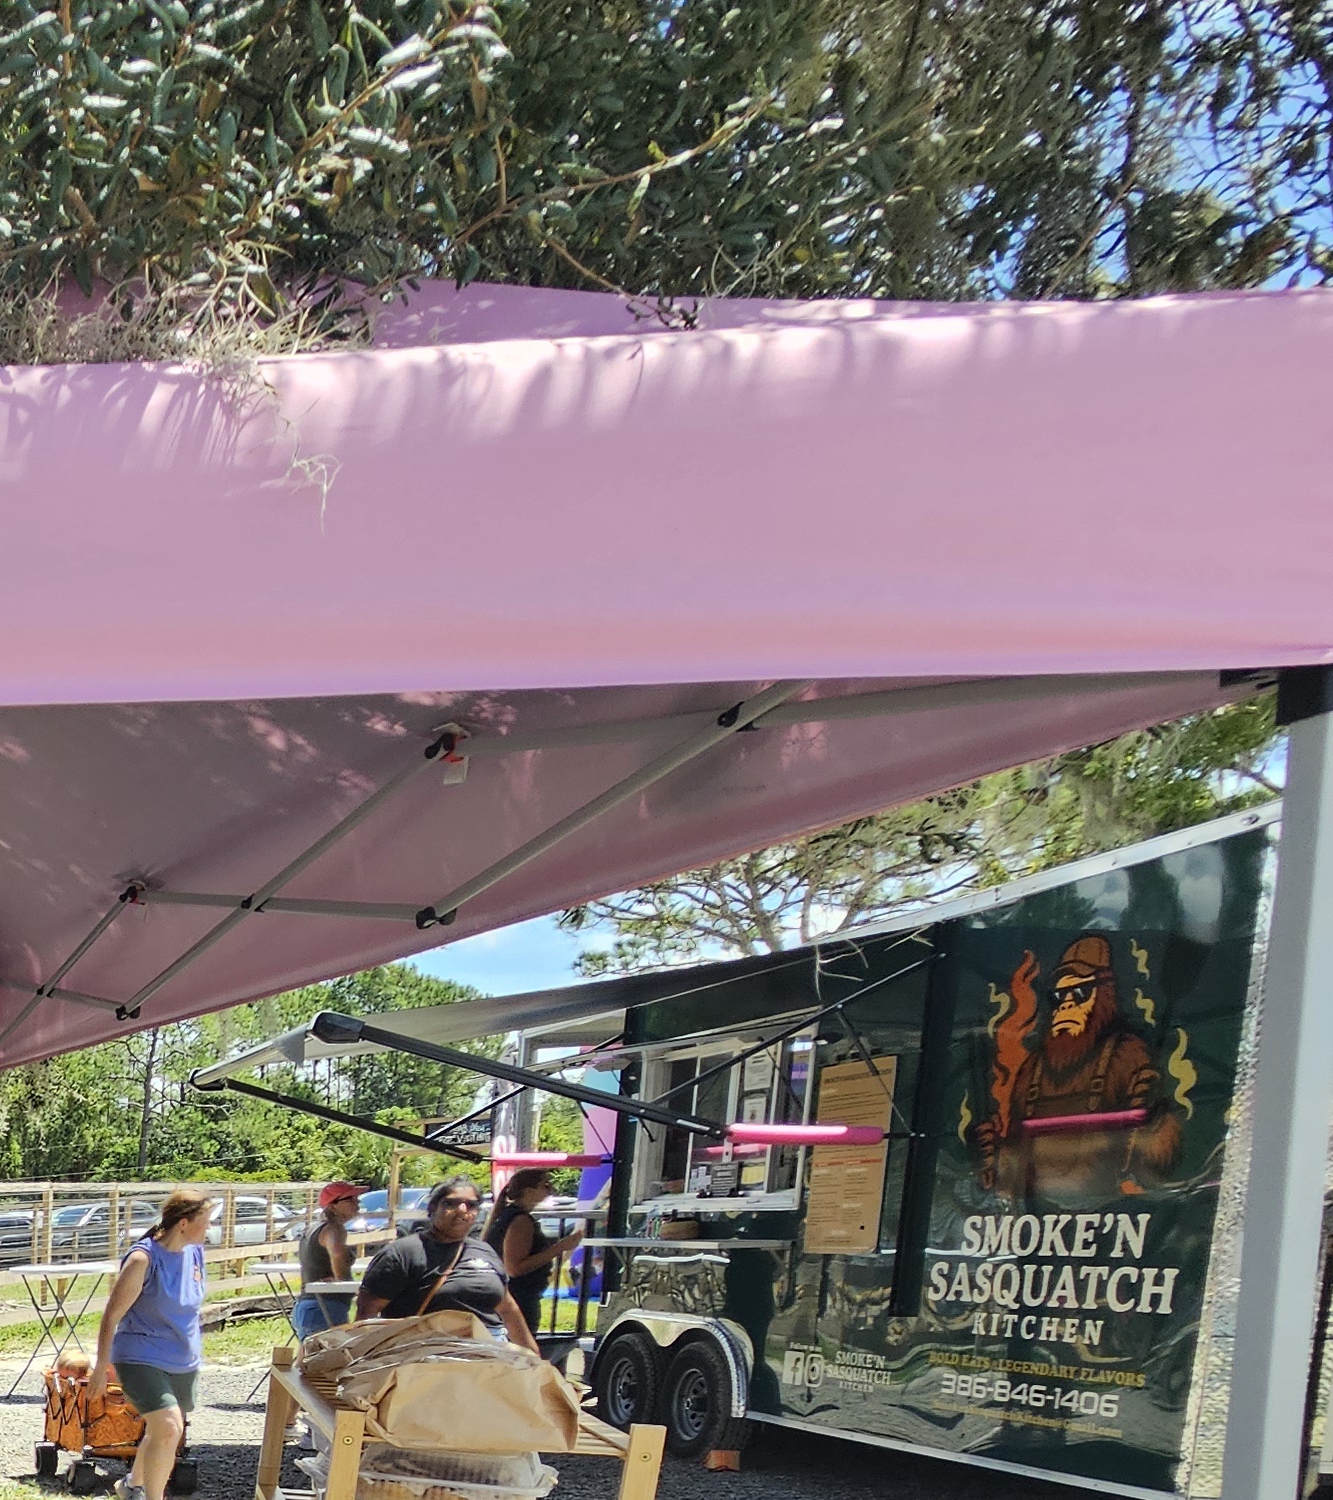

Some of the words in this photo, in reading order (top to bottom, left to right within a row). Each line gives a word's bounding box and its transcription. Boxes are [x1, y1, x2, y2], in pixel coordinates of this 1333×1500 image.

[961, 1213, 1151, 1259] SMOKE'N
[927, 1261, 1180, 1314] SASQUATCH
[971, 1312, 1105, 1345] KITCHEN
[826, 1364, 892, 1385] SASQUATCH
[835, 1351, 886, 1369] SMOKE'N
[997, 1359, 1077, 1380] LEGENDARY
[1079, 1369, 1146, 1388] FLAVORS
[941, 1373, 1120, 1418] 386-846-1406
